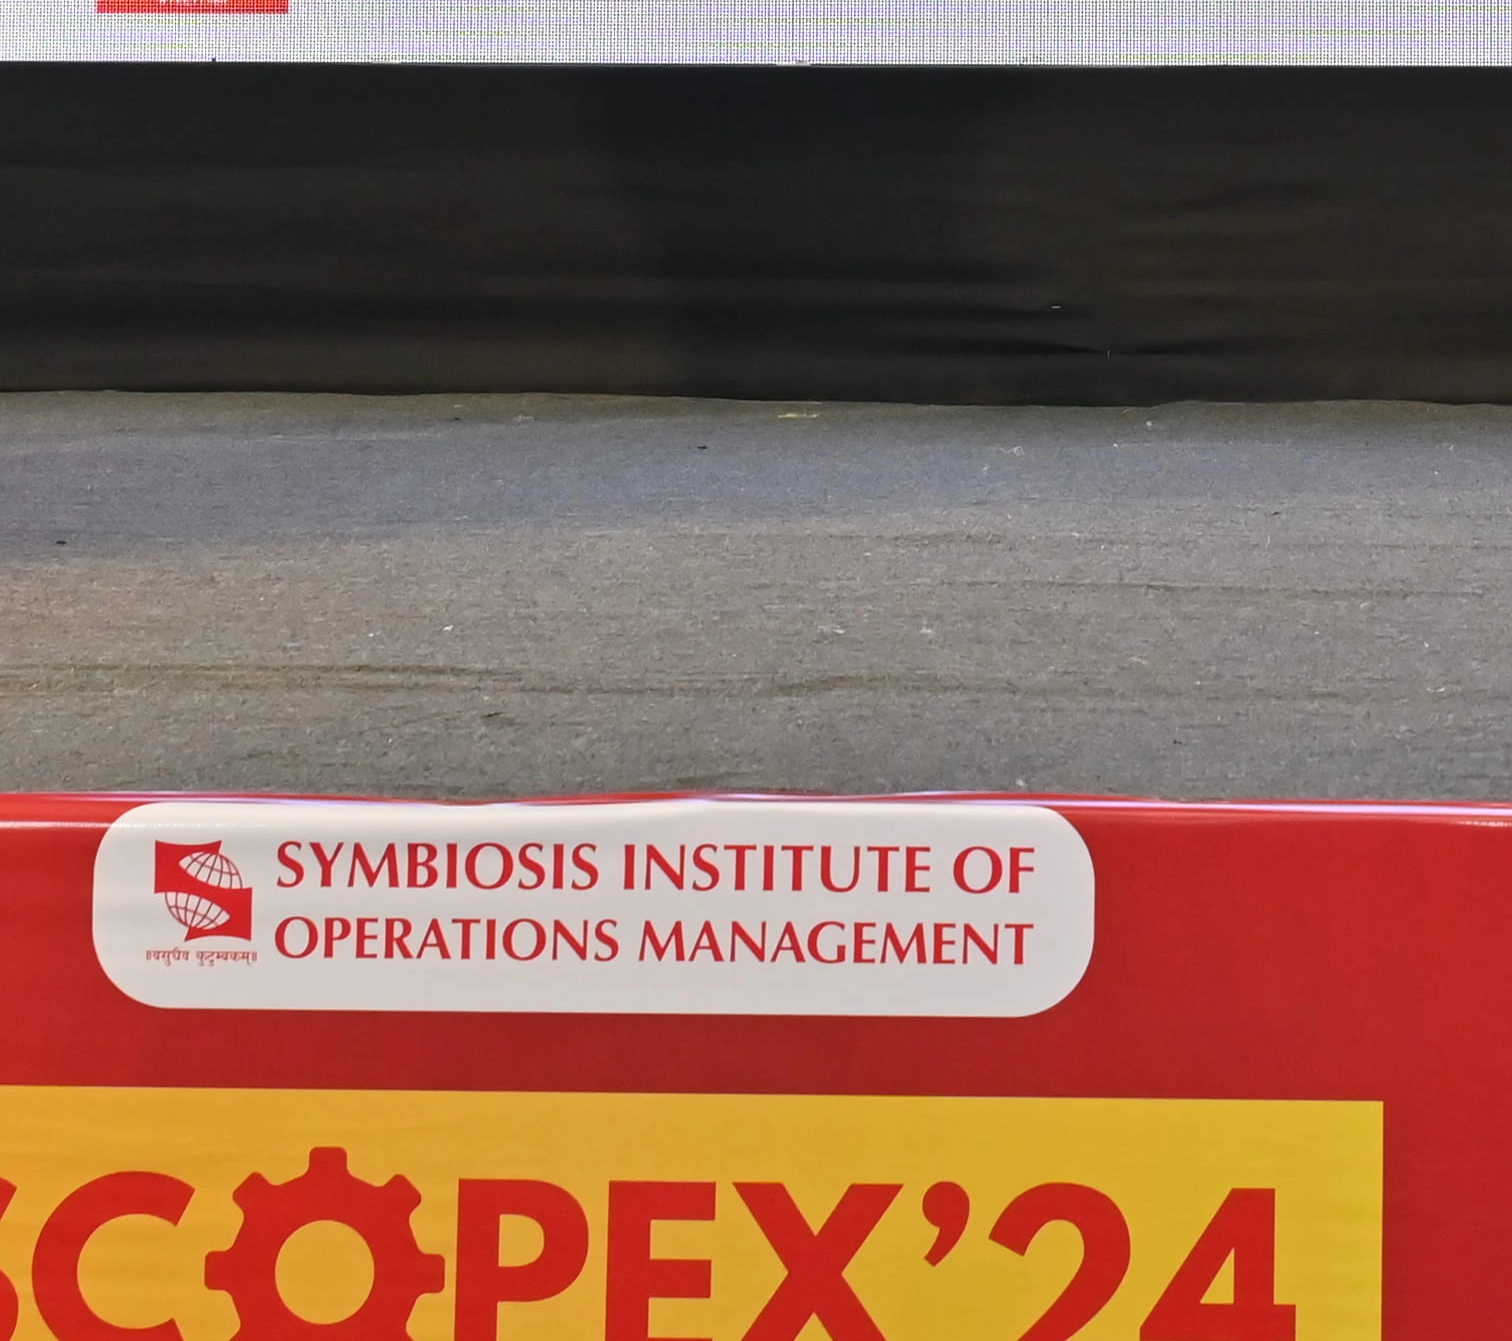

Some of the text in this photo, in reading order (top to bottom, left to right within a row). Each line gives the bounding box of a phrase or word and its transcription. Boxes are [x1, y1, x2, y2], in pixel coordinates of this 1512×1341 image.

[277, 841, 1034, 894] SYMBIOSIS INSTITUTE OF
[275, 916, 1034, 965] OPERATIONS MANAGEMENT
